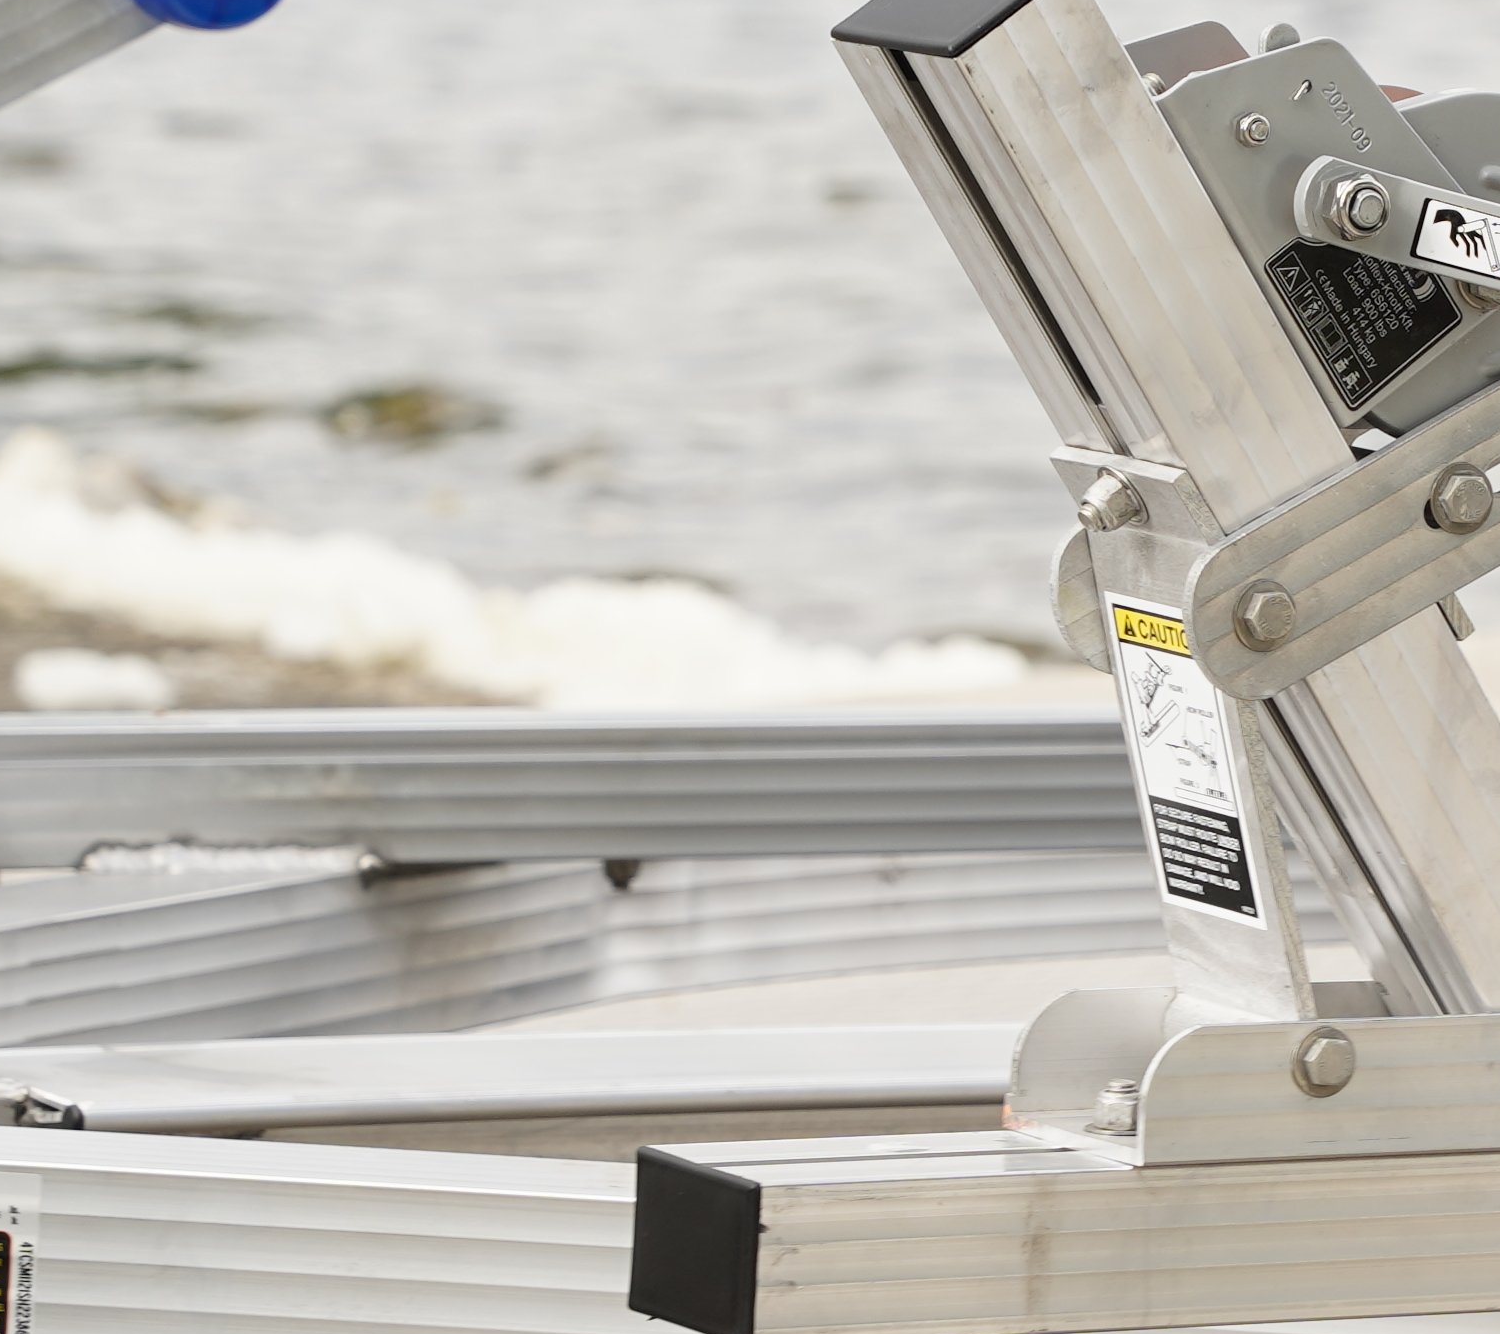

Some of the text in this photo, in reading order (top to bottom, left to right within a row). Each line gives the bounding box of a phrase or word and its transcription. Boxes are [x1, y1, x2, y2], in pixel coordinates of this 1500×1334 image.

[1320, 81, 1373, 153] 2021-09
[1342, 266, 1388, 338] Load: 900 lbs
[1350, 258, 1372, 291] Type:
[1370, 288, 1400, 331] 6S6120
[1361, 253, 1407, 320] toflex-Knott
[1379, 257, 1417, 313] nufacturer:
[1323, 280, 1379, 369] Made in Hungary
[1351, 305, 1376, 345] 414 kg
